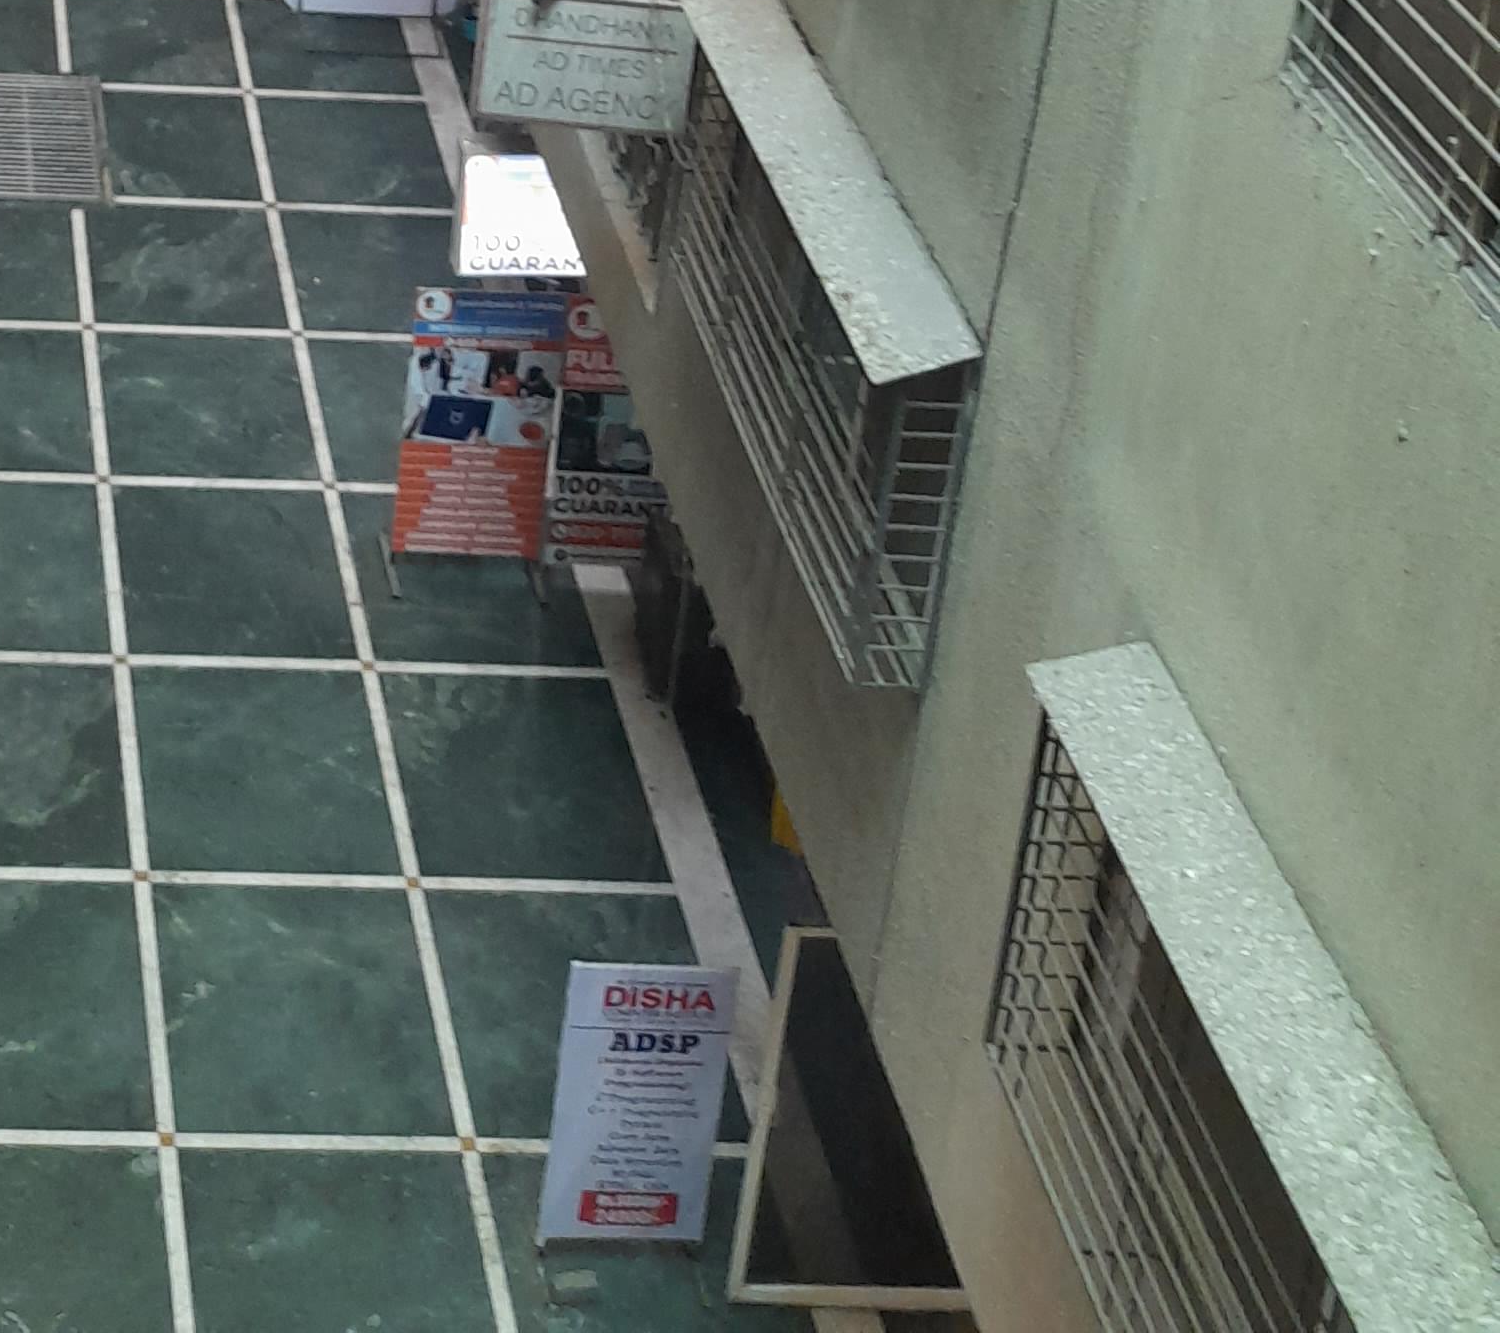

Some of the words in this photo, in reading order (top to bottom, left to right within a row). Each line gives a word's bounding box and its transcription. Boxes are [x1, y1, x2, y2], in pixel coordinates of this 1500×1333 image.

[494, 80, 540, 108] AD
[546, 86, 665, 121] AGENC
[473, 234, 522, 253] 100
[603, 985, 716, 1012] DISHA
[609, 1032, 702, 1055] ADSP
